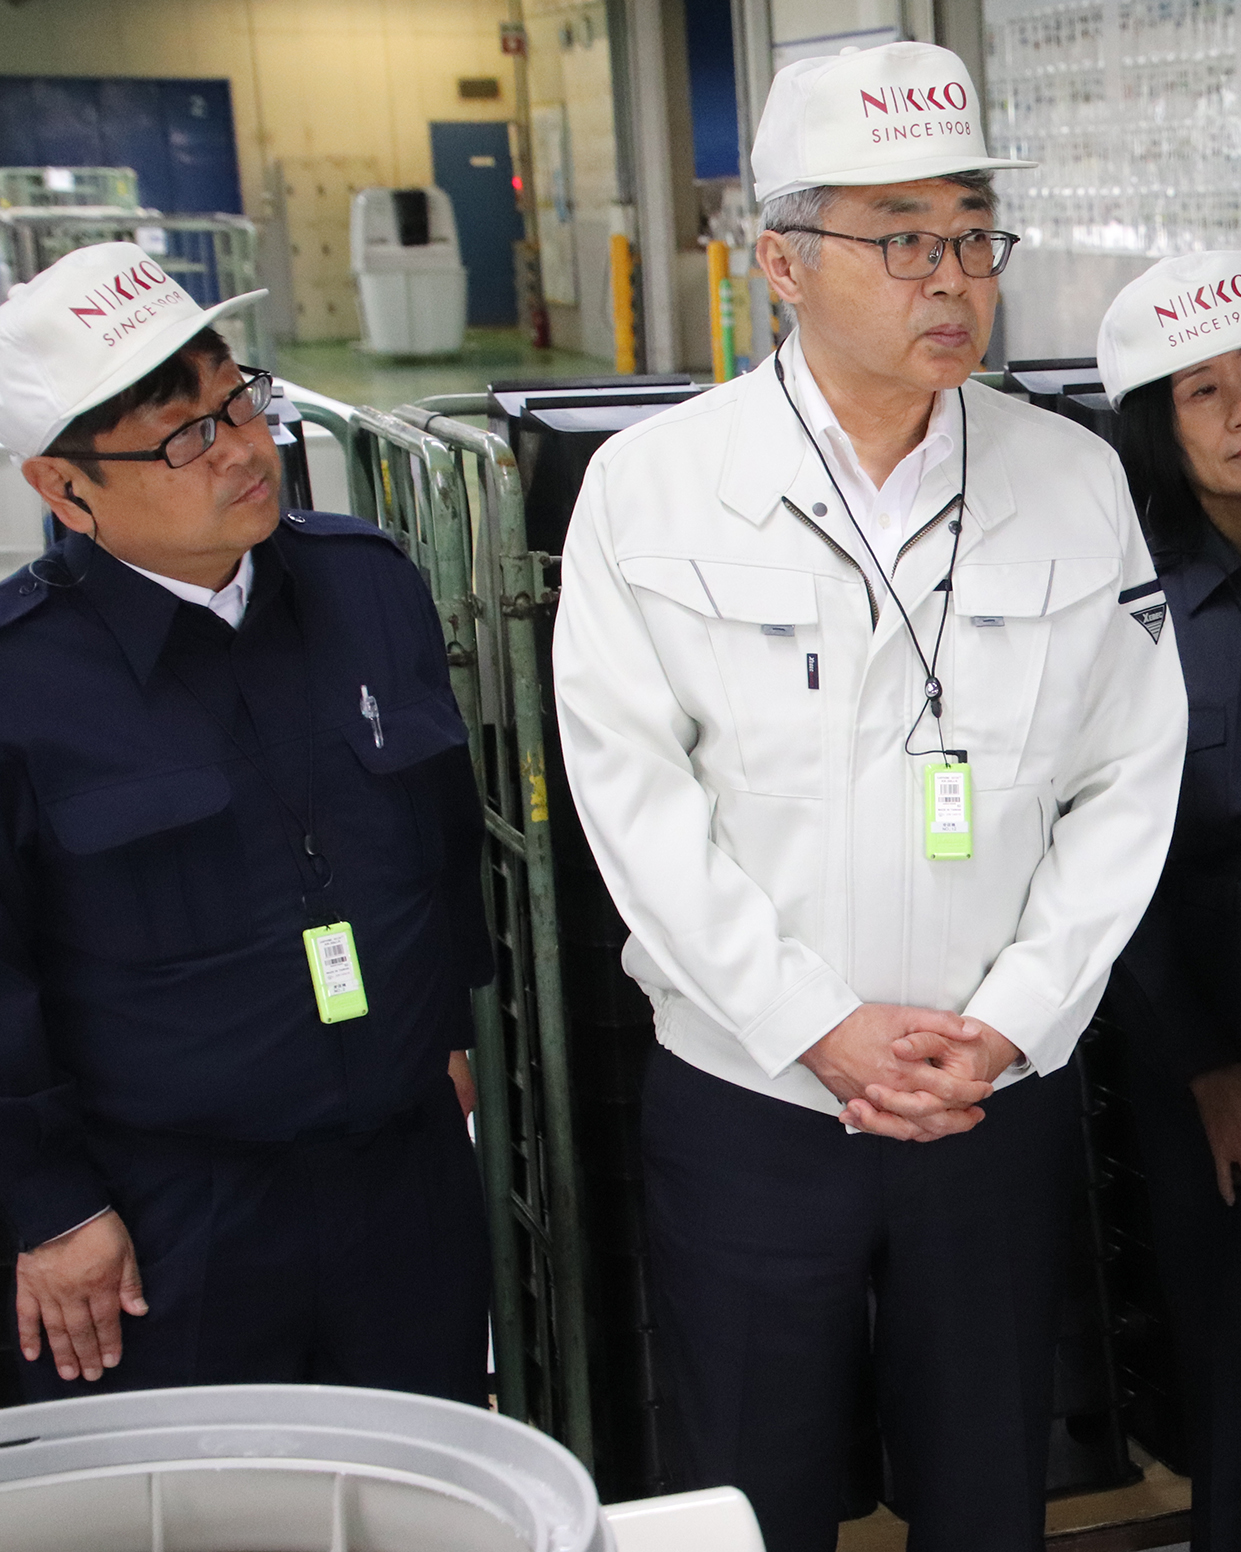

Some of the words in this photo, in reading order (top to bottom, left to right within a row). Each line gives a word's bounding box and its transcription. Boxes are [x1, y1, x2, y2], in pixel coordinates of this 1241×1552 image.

[860, 82, 967, 118] NIKKO
[872, 122, 934, 143] SINCE
[938, 121, 971, 136] 1908
[68, 260, 167, 329] NIKKO
[103, 304, 157, 347] SINCE
[1168, 318, 1221, 347] SINCE
